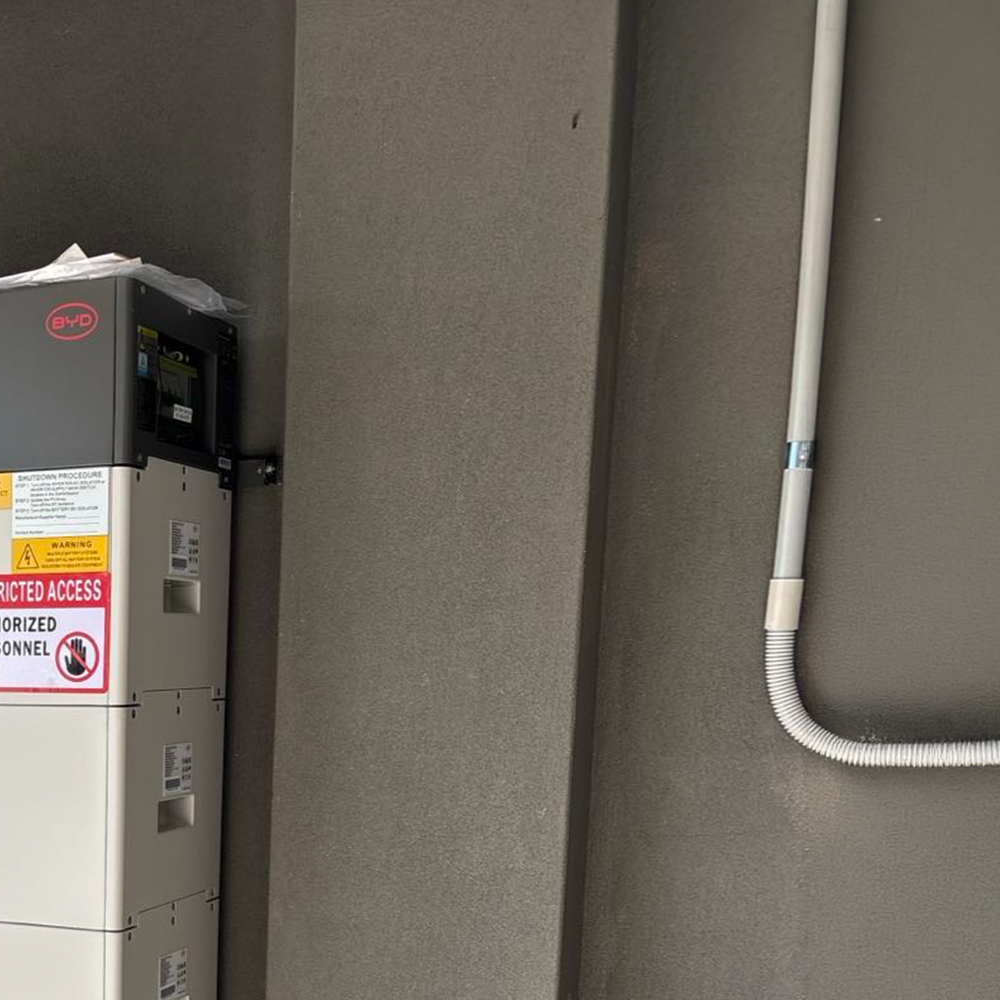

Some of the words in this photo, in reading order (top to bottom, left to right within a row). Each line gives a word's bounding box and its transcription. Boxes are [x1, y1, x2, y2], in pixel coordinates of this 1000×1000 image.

[52, 314, 92, 329] BYD
[58, 471, 102, 479] PROCEDURE
[51, 540, 93, 549] WARNING
[47, 579, 102, 602] ACCESS
